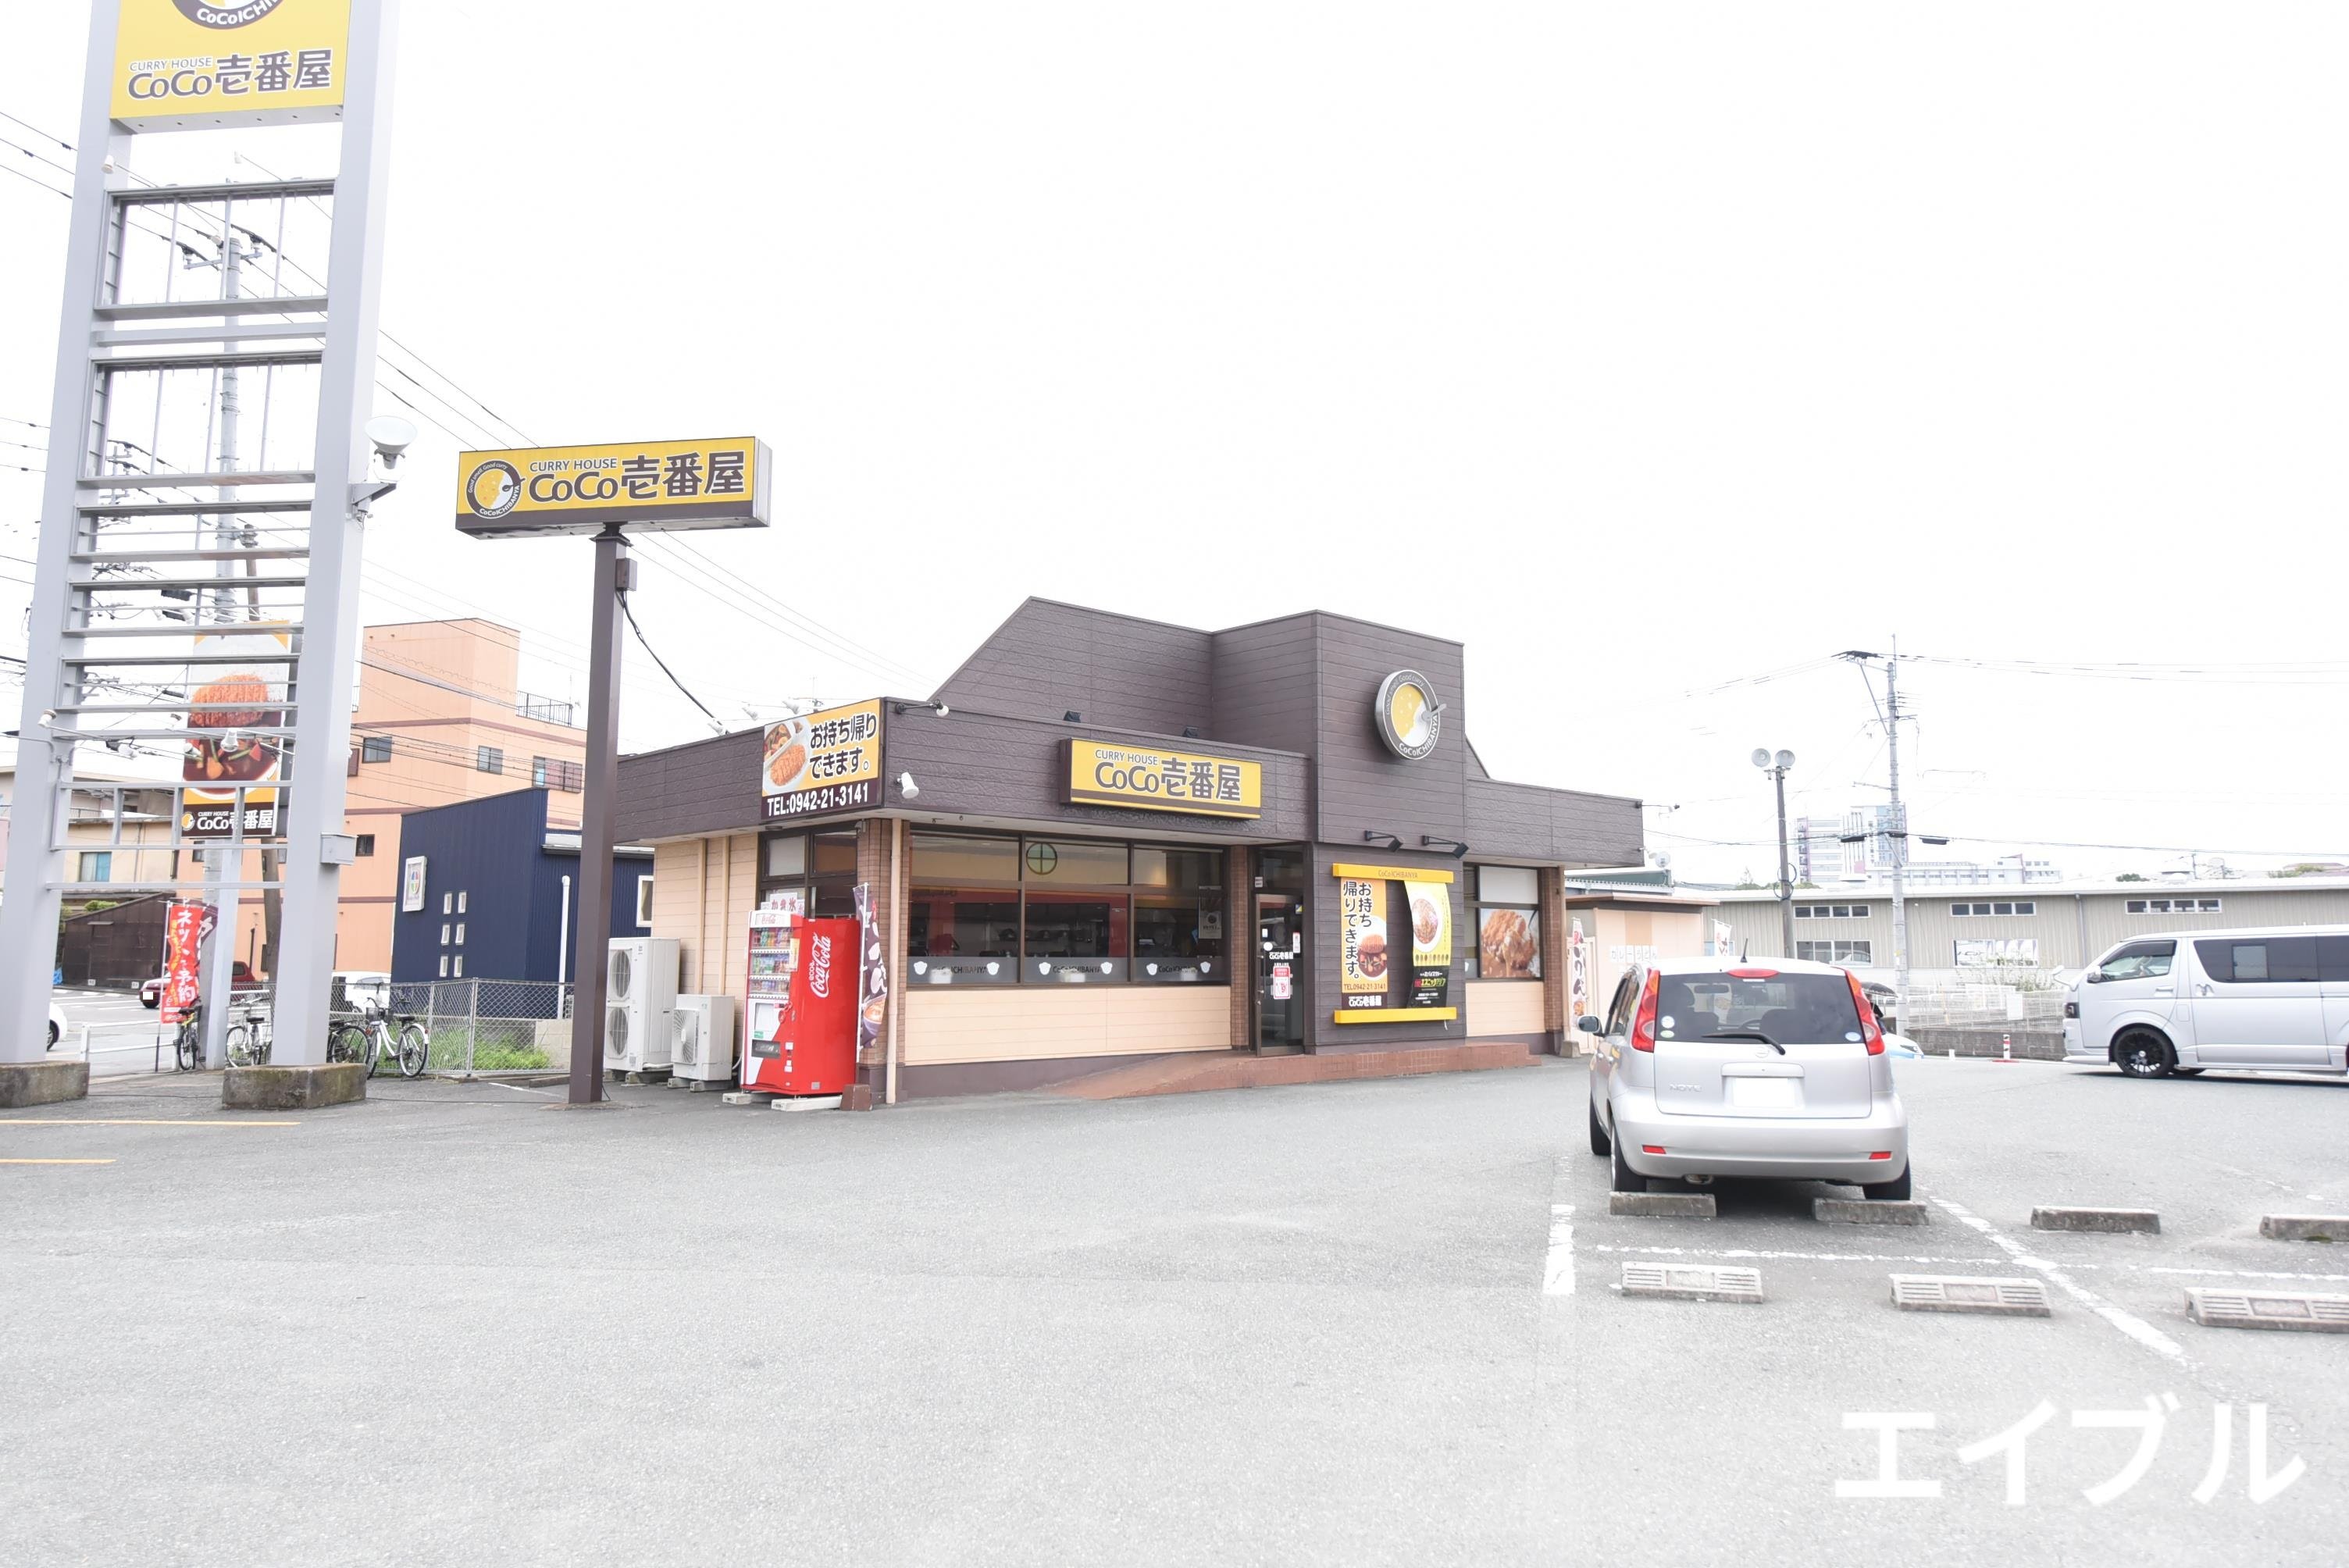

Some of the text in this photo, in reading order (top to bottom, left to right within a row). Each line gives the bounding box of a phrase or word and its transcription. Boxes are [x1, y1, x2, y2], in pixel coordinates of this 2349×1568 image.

[128, 49, 332, 100] CoCo壱番屋
[130, 57, 212, 72] CURRY HOUSE
[529, 458, 618, 472] CURRY HOUSE
[529, 451, 744, 503] CoCo壱番屋
[479, 484, 520, 516] CoCoICHIBANYA
[810, 713, 877, 750] お持ち帰り
[1398, 715, 1438, 757] CoCoICHIBANYA
[809, 747, 869, 779] できます。
[1095, 749, 1158, 765] CURRY HOUSE
[1095, 757, 1242, 801] CoCo壱番屋
[767, 782, 869, 817] TEL:0942-21-3141
[1358, 882, 1373, 928] お持ち
[1342, 880, 1360, 979] 帰りできます。
